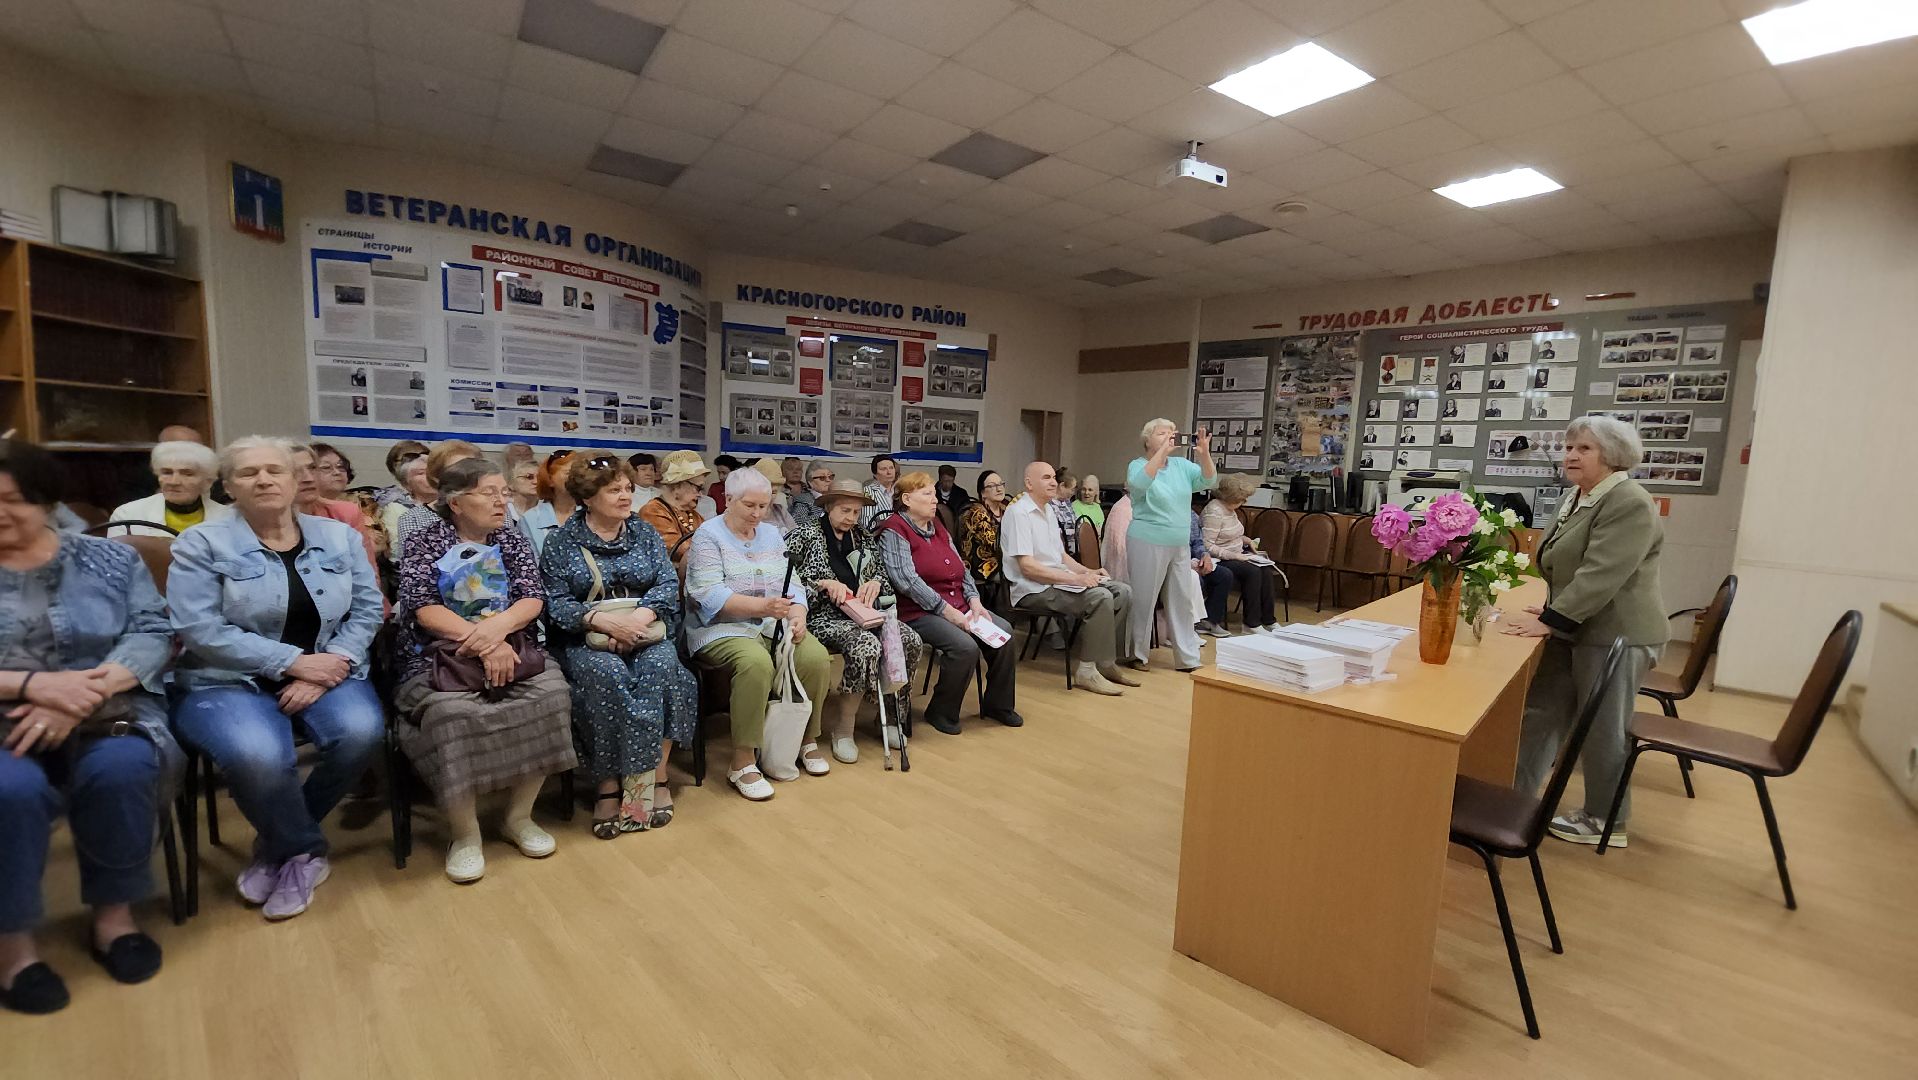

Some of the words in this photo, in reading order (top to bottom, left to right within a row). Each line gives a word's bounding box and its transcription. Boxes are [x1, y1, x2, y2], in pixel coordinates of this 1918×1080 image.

[318, 228, 375, 240] СТРАНИЦЫ
[345, 189, 572, 247] ВЕТЕРАНСКАЯ
[363, 241, 412, 253] ИСТОРИИ
[485, 250, 555, 270] РАЙОННЫЙ
[562, 264, 599, 278] СОВЕТ
[602, 272, 654, 293] ВЕТЕРАНОВ
[736, 284, 904, 319] КРАСНОГОРСКОГО
[912, 305, 967, 327] РАЙОН
[1299, 306, 1409, 331] ТРУДОВАЯ
[1418, 293, 1559, 325] ДОБЛЕСТЬ
[1400, 333, 1423, 341] ГЕРОИ
[1426, 327, 1517, 340] СОЦИАЛИСТИЧЕСКОГО
[1521, 325, 1549, 333] ТРУДА
